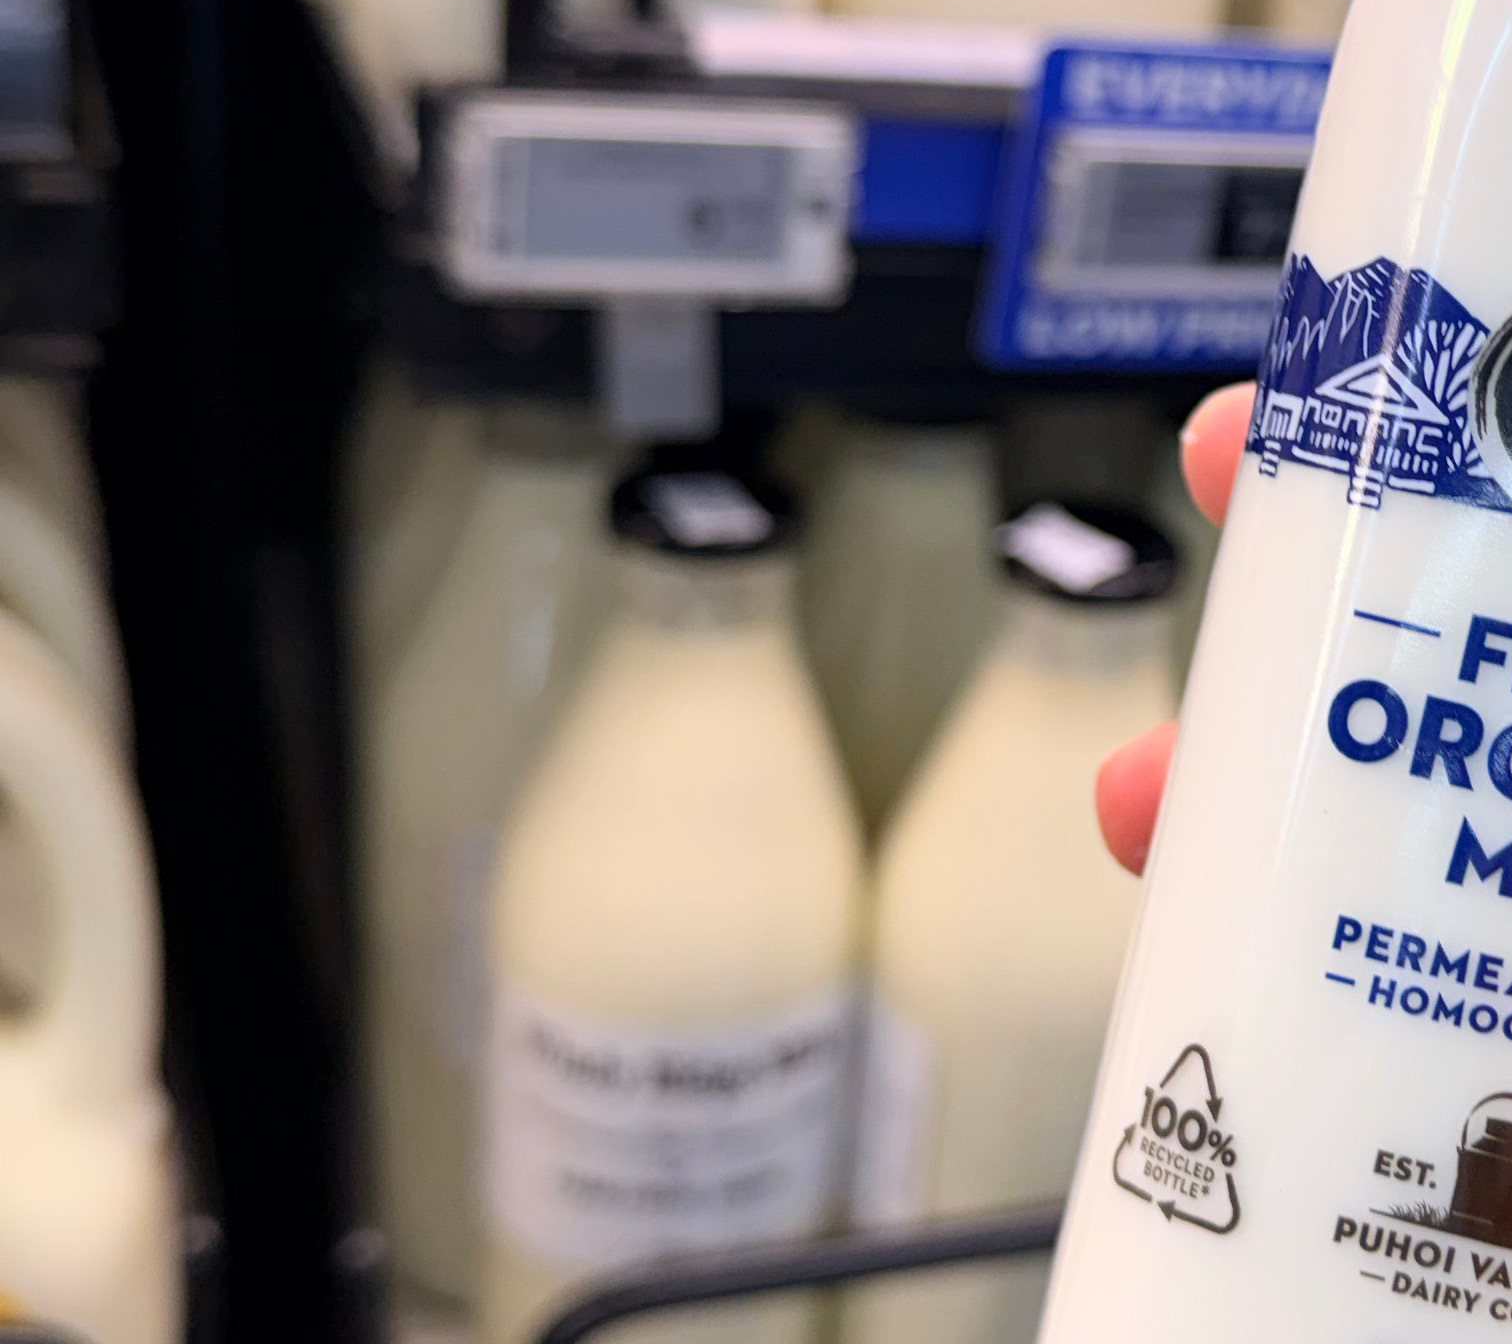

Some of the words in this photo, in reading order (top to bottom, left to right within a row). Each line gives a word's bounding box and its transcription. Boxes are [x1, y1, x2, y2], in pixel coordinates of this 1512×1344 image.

[1140, 1085, 1238, 1168] 100%
[1139, 1135, 1216, 1184] RECYCLED
[1372, 1147, 1438, 1190] EST.
[1332, 1214, 1457, 1274] PUHOI
[1390, 1269, 1482, 1314] DAIRY
